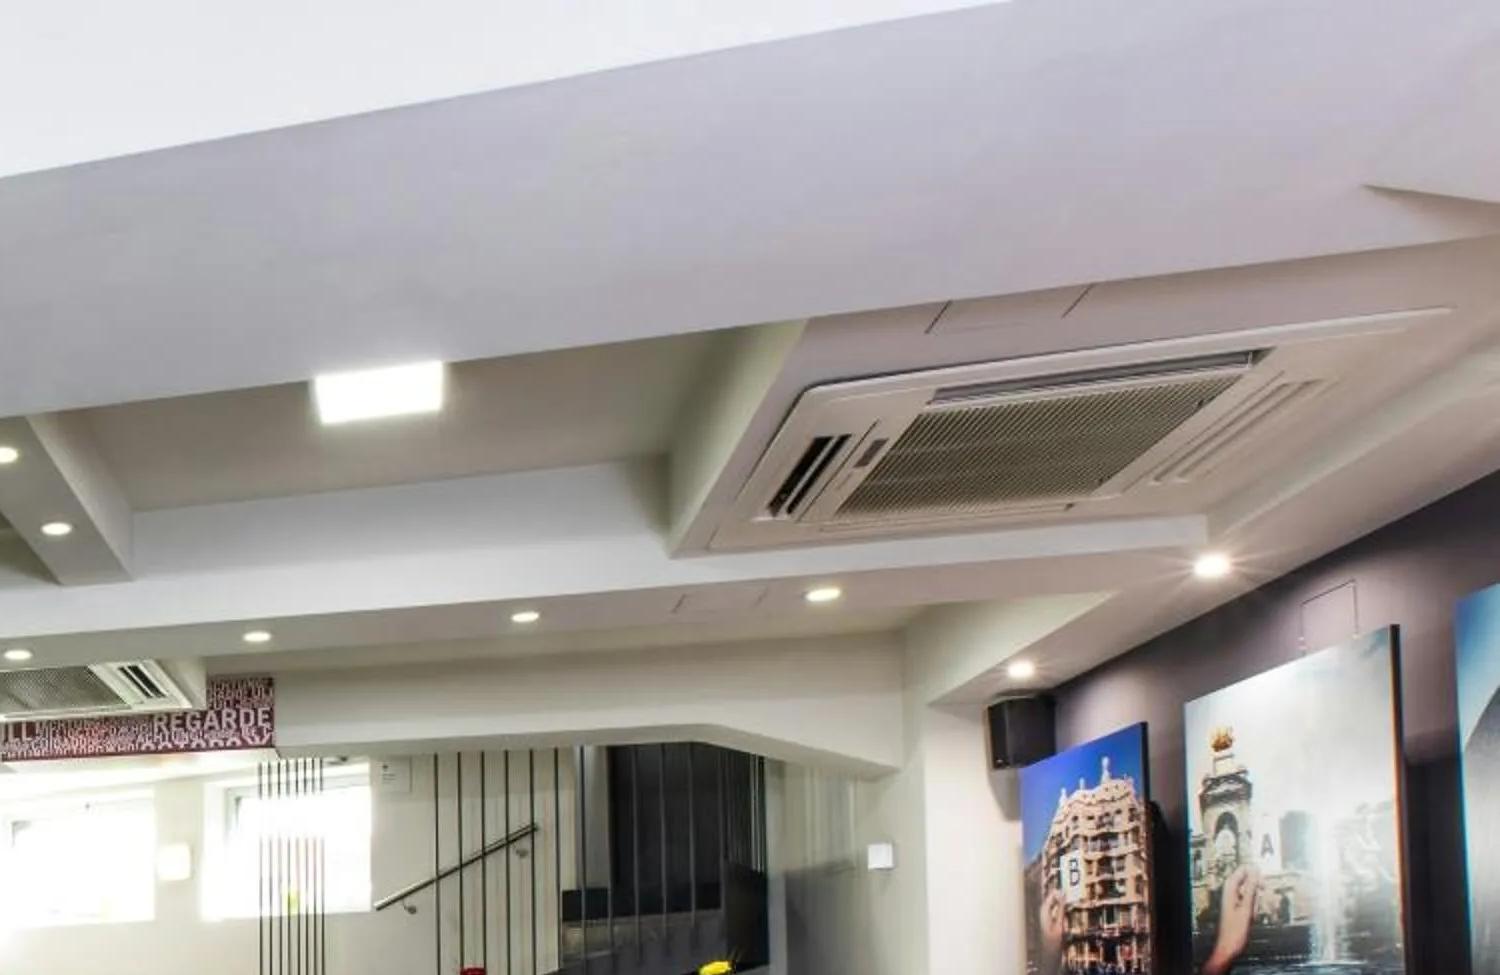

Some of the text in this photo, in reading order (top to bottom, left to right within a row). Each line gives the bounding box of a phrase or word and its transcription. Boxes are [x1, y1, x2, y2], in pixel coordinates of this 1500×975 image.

[153, 707, 271, 733] REGARDE
[1260, 832, 1274, 857] A
[1068, 857, 1082, 887] B
